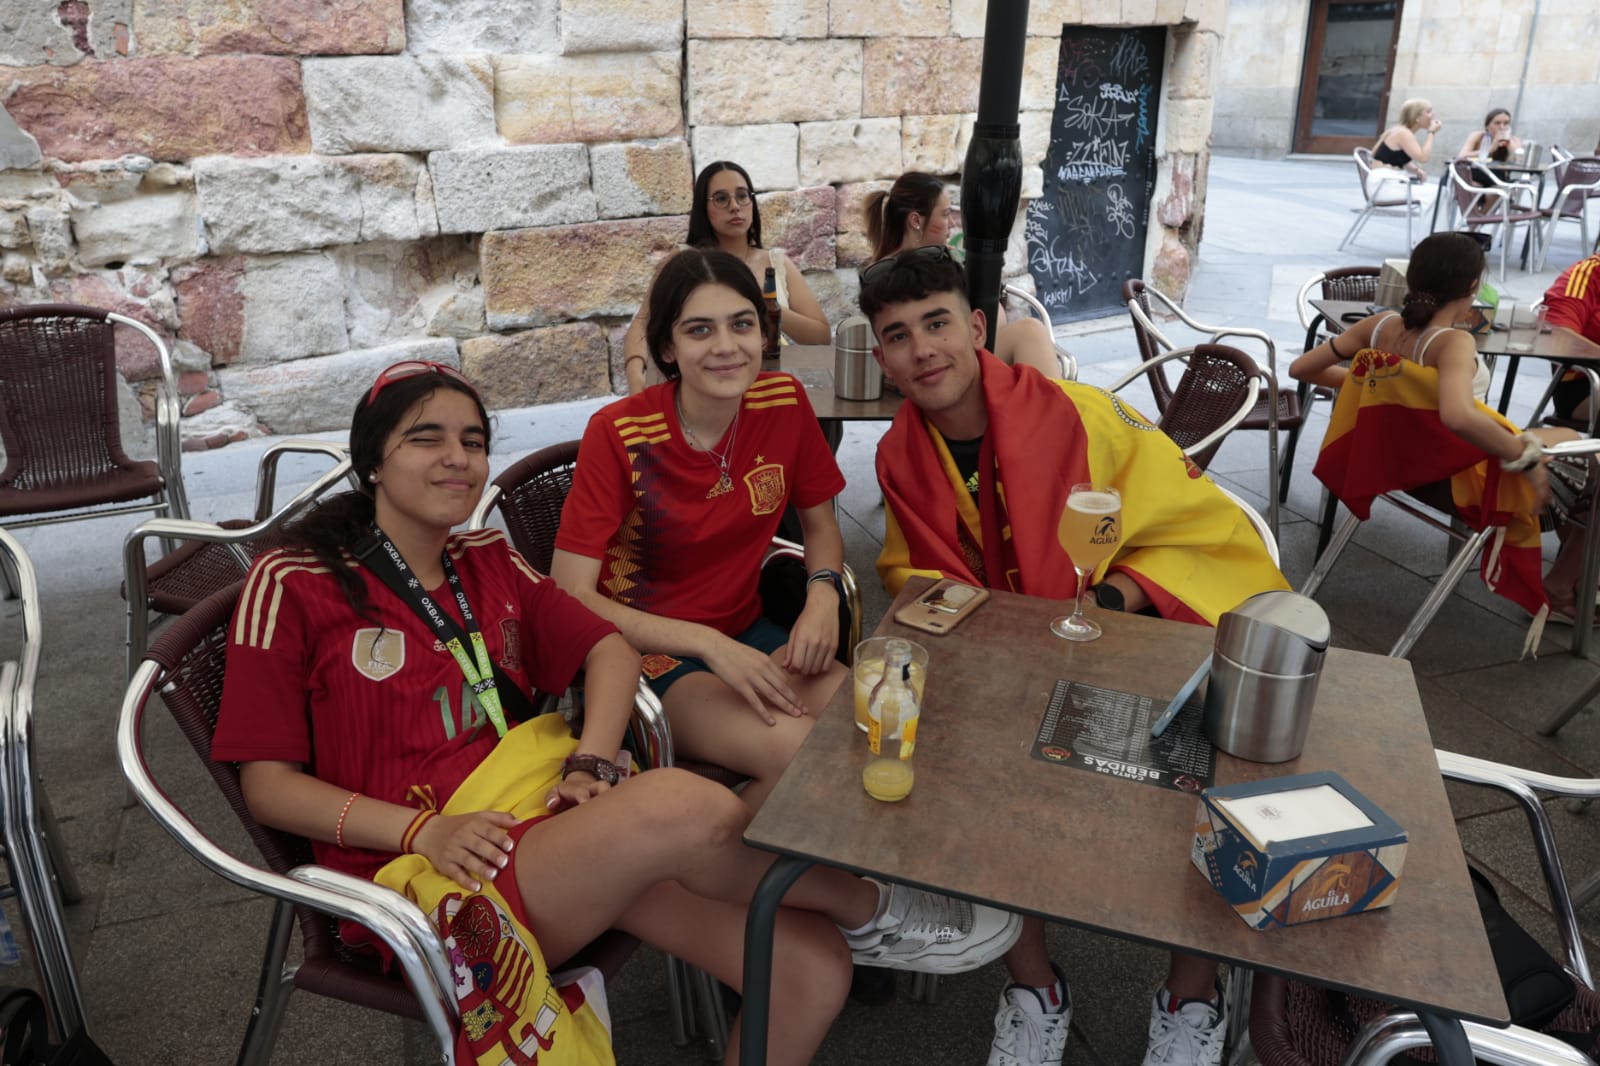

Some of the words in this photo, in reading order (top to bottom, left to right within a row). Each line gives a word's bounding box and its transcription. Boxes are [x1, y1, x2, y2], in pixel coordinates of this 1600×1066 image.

[383, 541, 407, 572] OXBAR
[421, 597, 445, 628] OXBAR
[456, 592, 473, 621] OXBAR
[1084, 756, 1160, 780] BEBIDAS
[1096, 766, 1110, 774] DE
[1112, 769, 1144, 781] CARTA
